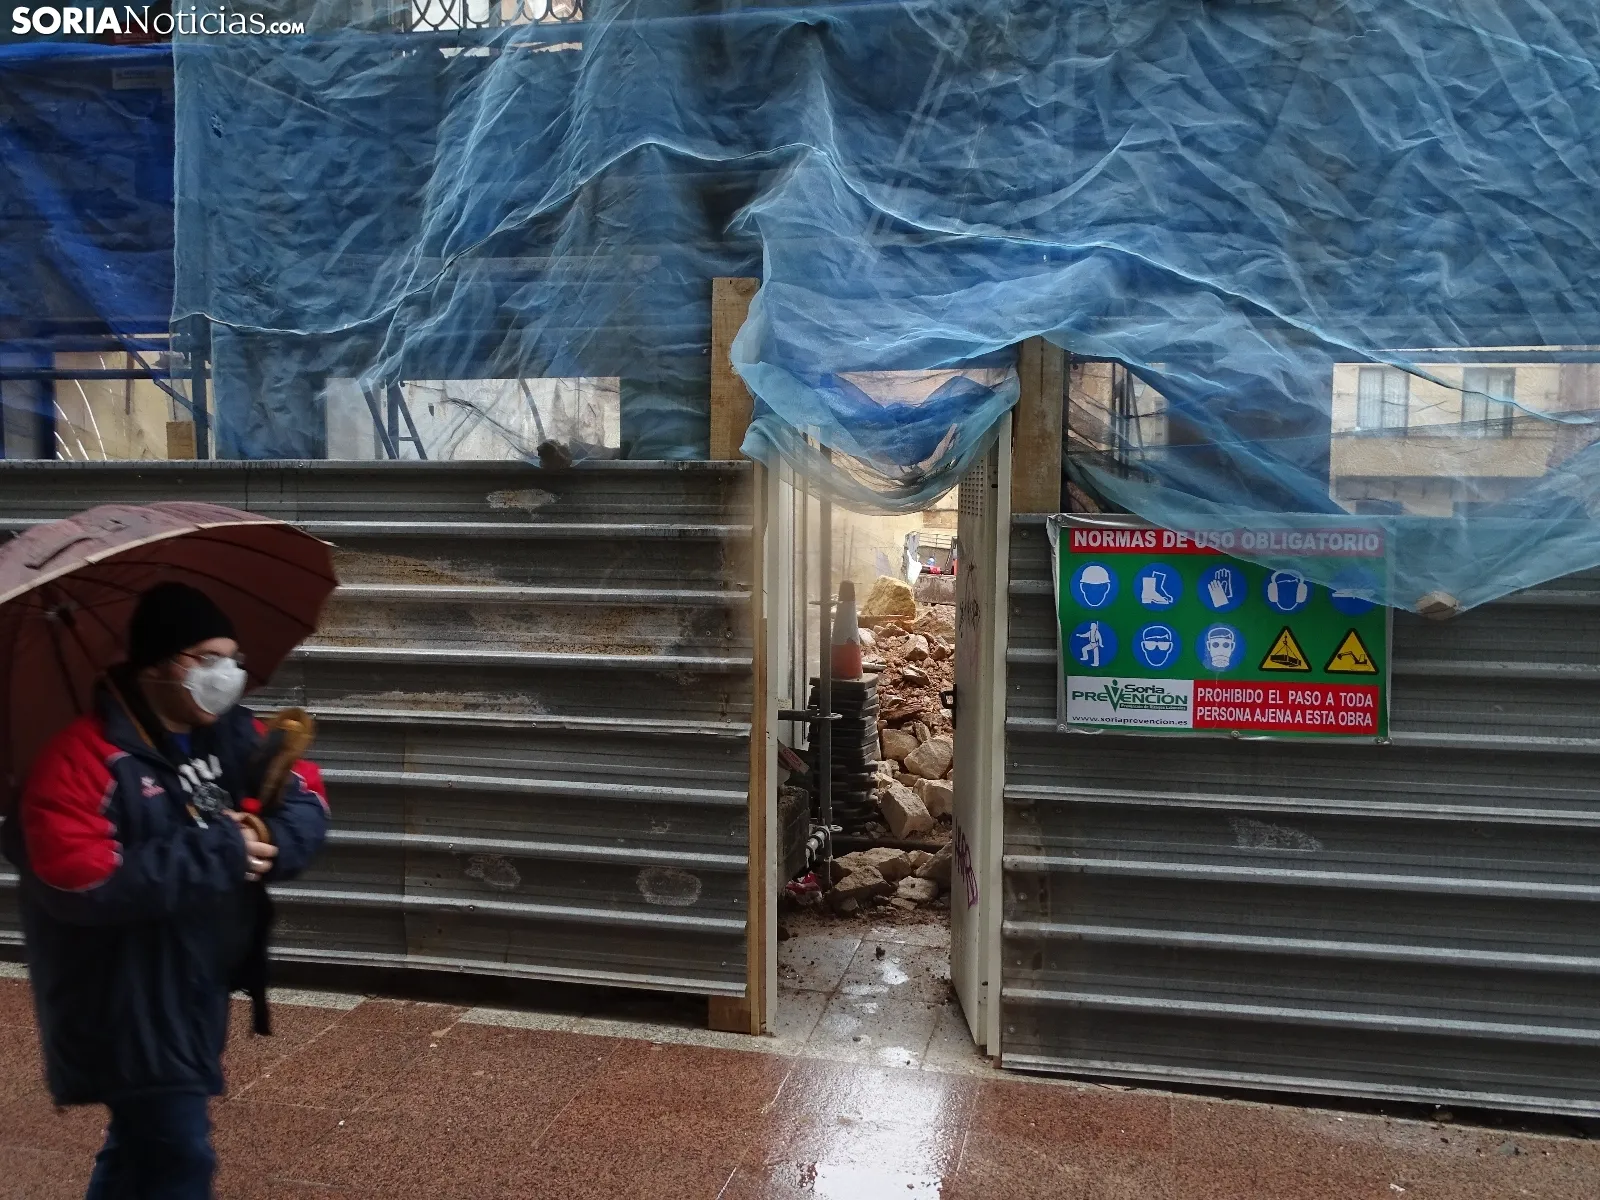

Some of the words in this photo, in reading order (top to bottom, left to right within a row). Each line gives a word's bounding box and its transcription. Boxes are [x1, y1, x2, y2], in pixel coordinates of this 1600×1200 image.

[1074, 530, 1157, 548] NORMAS
[1163, 531, 1188, 548] DE
[1194, 531, 1235, 549] USO
[1240, 531, 1379, 551] OBLIGATORIO
[1124, 684, 1165, 694] Soria
[1197, 687, 1264, 704] PROHIBIDO
[1268, 690, 1284, 704] EL
[1288, 690, 1322, 706] PASO
[1325, 692, 1335, 706] A
[1339, 692, 1374, 708] TODA
[1072, 716, 1188, 726] www.soriaprevencion.es
[1196, 706, 1251, 722] PERSONA
[1253, 708, 1293, 723] AJENA
[1294, 709, 1303, 724] A
[1305, 710, 1336, 725] ESTA
[1338, 711, 1373, 727] OBRA
